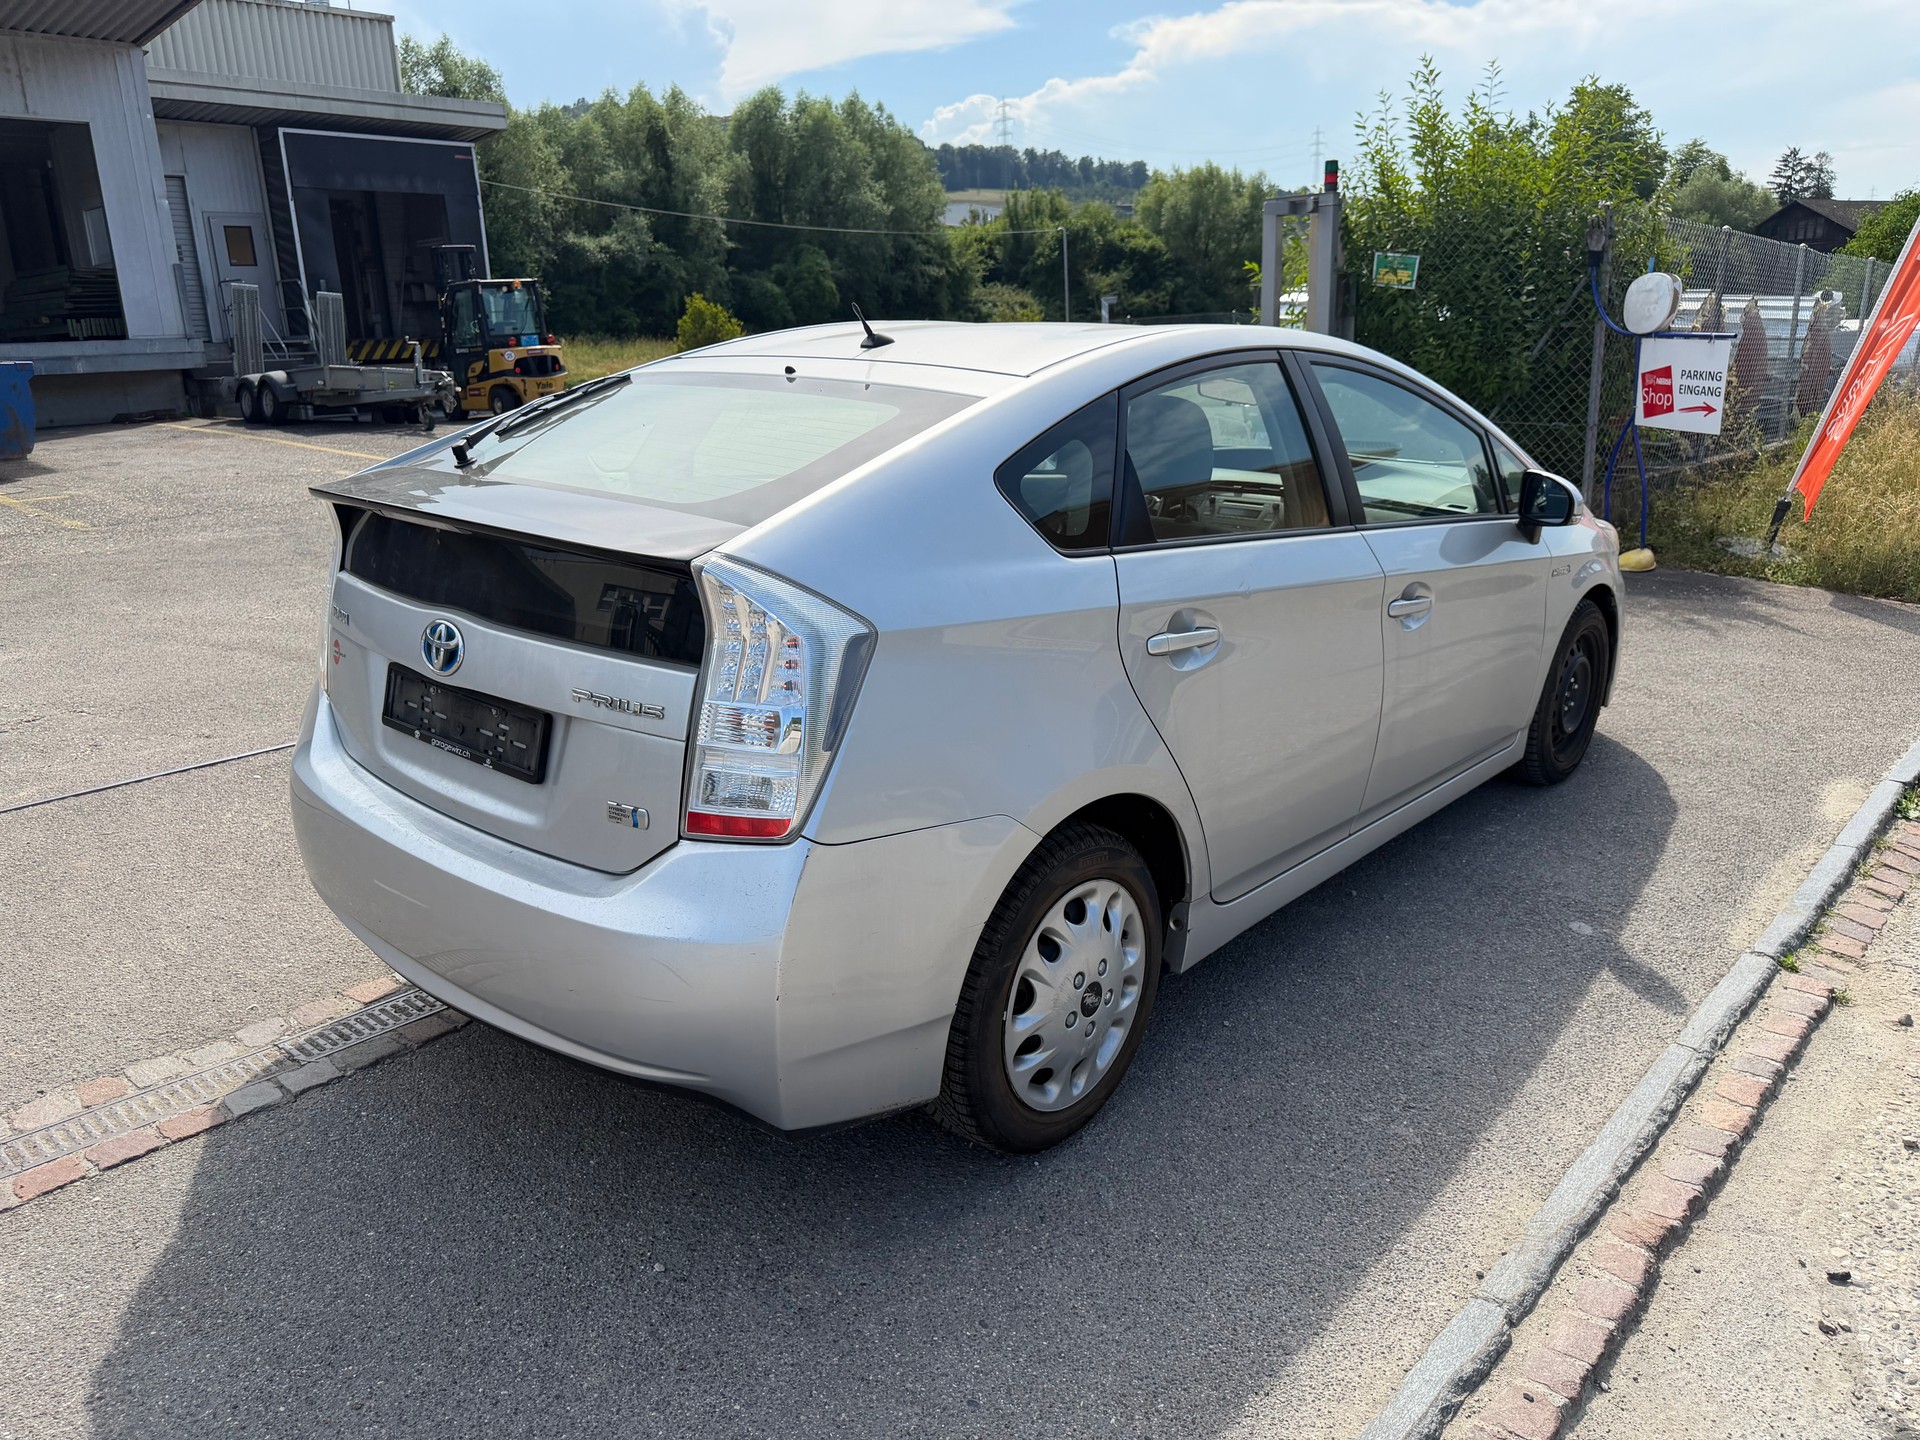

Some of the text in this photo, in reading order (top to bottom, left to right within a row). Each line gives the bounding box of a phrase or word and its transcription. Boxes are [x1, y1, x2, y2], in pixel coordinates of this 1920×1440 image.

[1680, 369, 1723, 382] PARKING
[536, 381, 554, 390] Yale
[1678, 384, 1722, 398] EINGANG
[1642, 387, 1673, 410] Shop
[572, 687, 665, 720] PRIUS
